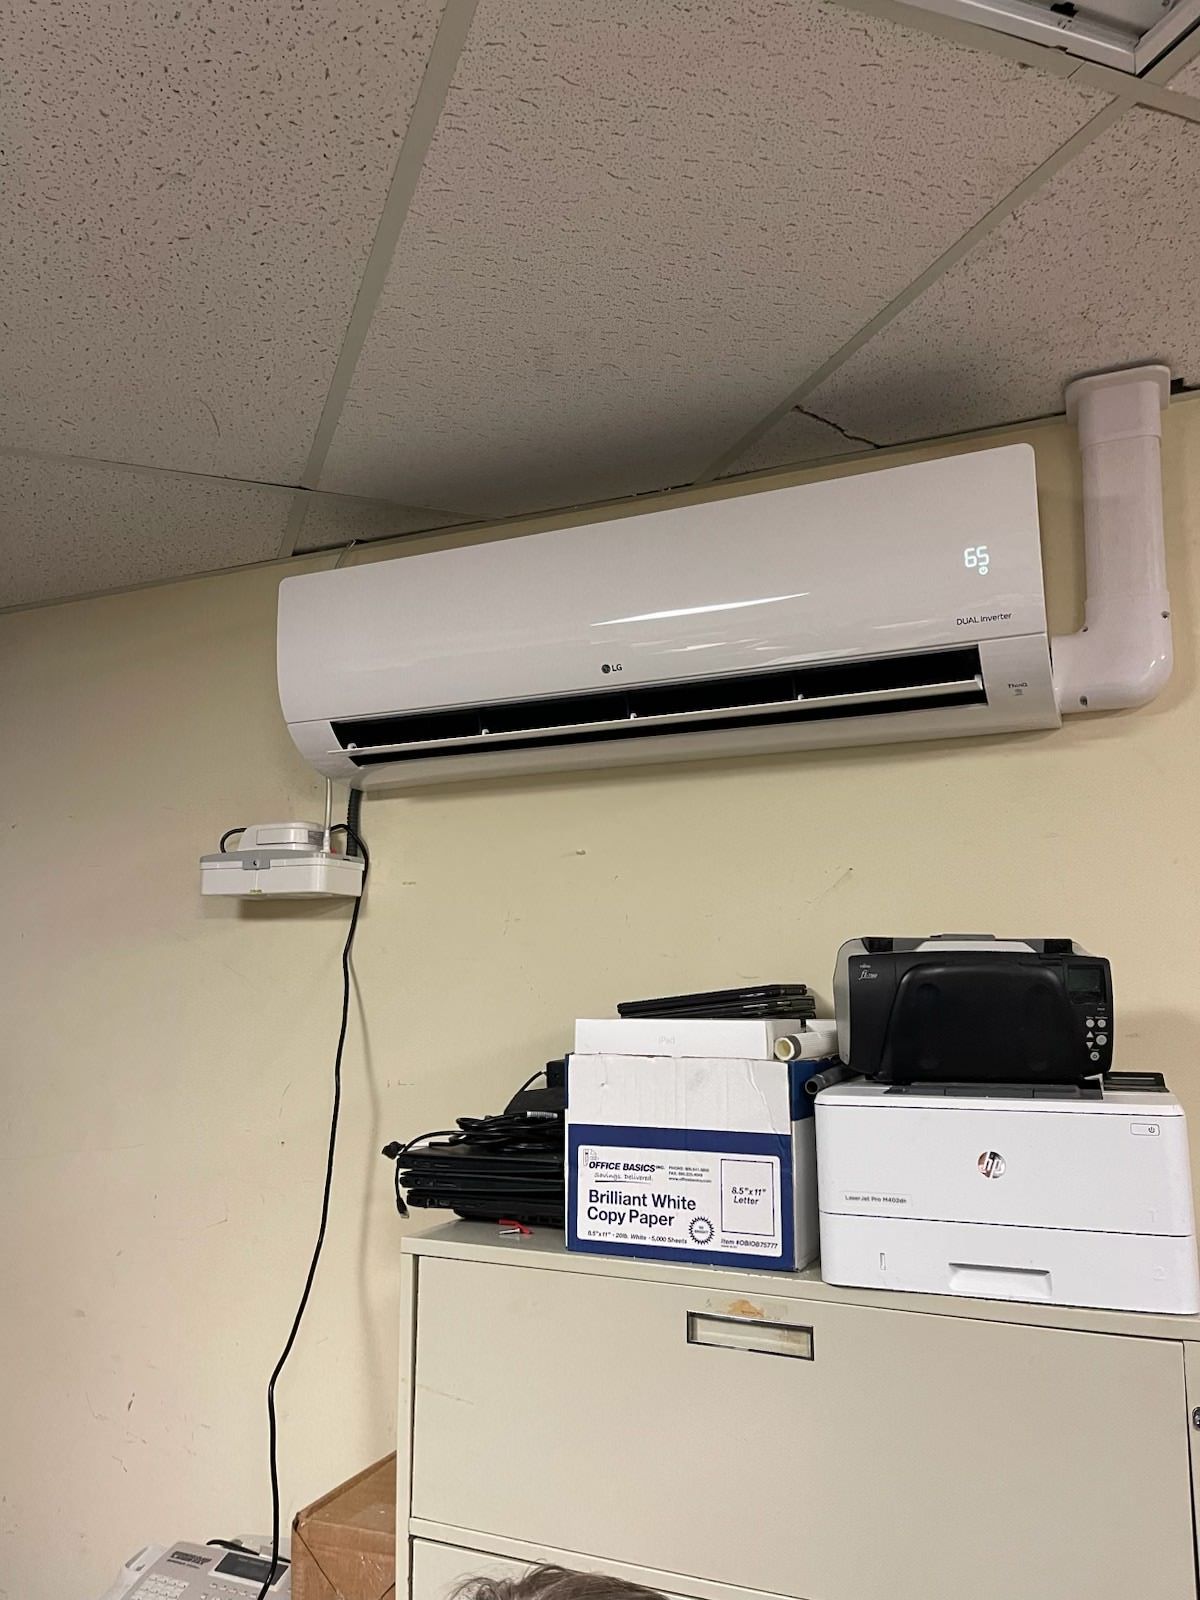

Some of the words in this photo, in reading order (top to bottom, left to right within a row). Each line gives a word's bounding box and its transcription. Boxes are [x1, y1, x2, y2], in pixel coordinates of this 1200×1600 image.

[964, 545, 990, 568] 65
[956, 616, 979, 626] DUAL
[588, 1161, 621, 1171] OFFICE
[622, 1163, 656, 1173] BASICS
[978, 1151, 1006, 1180] hp
[588, 1189, 648, 1207] Brilliant
[651, 1193, 697, 1211] White
[733, 1195, 759, 1205] Letter
[587, 1206, 626, 1226] Copy
[629, 1209, 675, 1228] Paper
[630, 1233, 647, 1241] White
